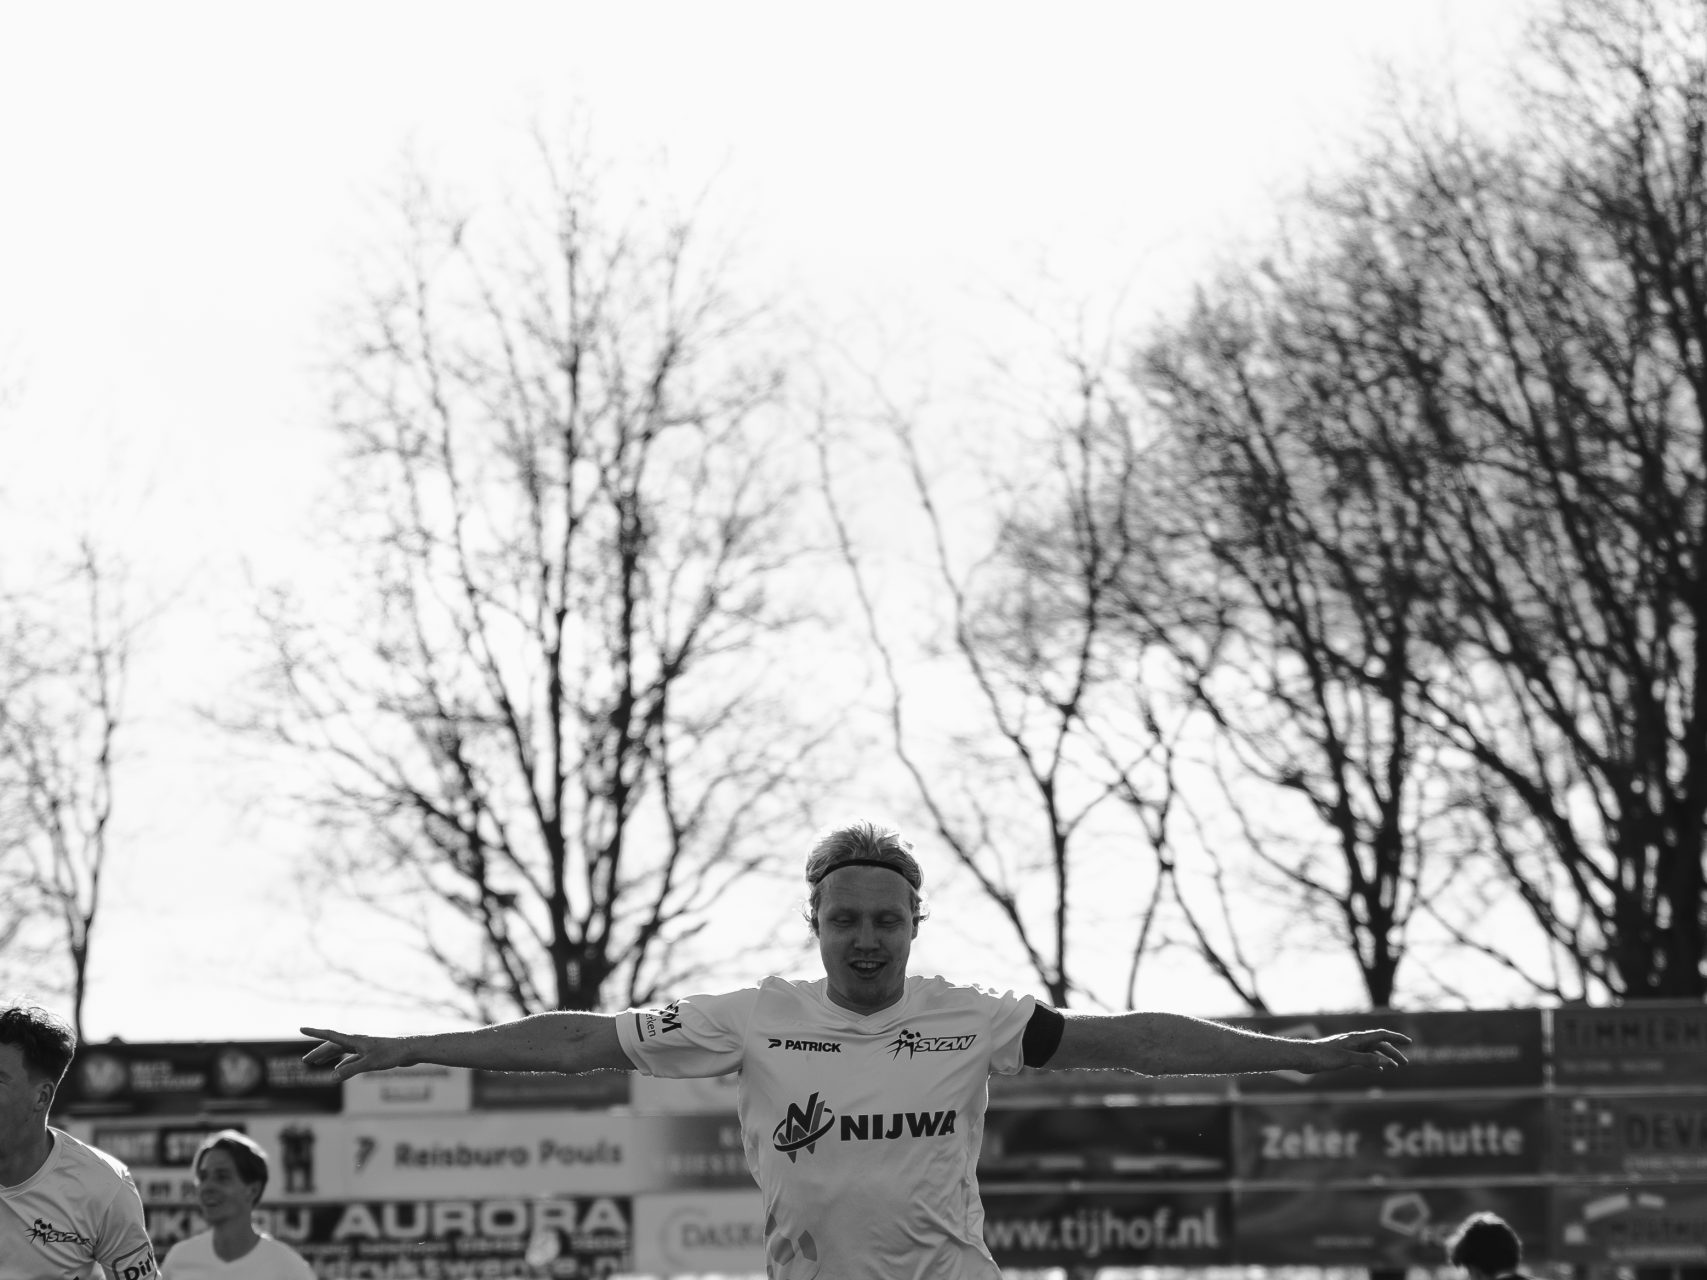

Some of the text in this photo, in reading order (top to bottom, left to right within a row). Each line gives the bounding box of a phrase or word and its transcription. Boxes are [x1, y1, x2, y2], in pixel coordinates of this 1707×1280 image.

[785, 1039, 842, 1053] PATRICK
[840, 1109, 957, 1141] NIJWA
[1260, 1118, 1524, 1160] Zeker Schutte
[393, 1140, 532, 1169] Reisburo
[334, 1201, 627, 1239] AURORA
[984, 1205, 1220, 1258] ww.tijhof.nl
